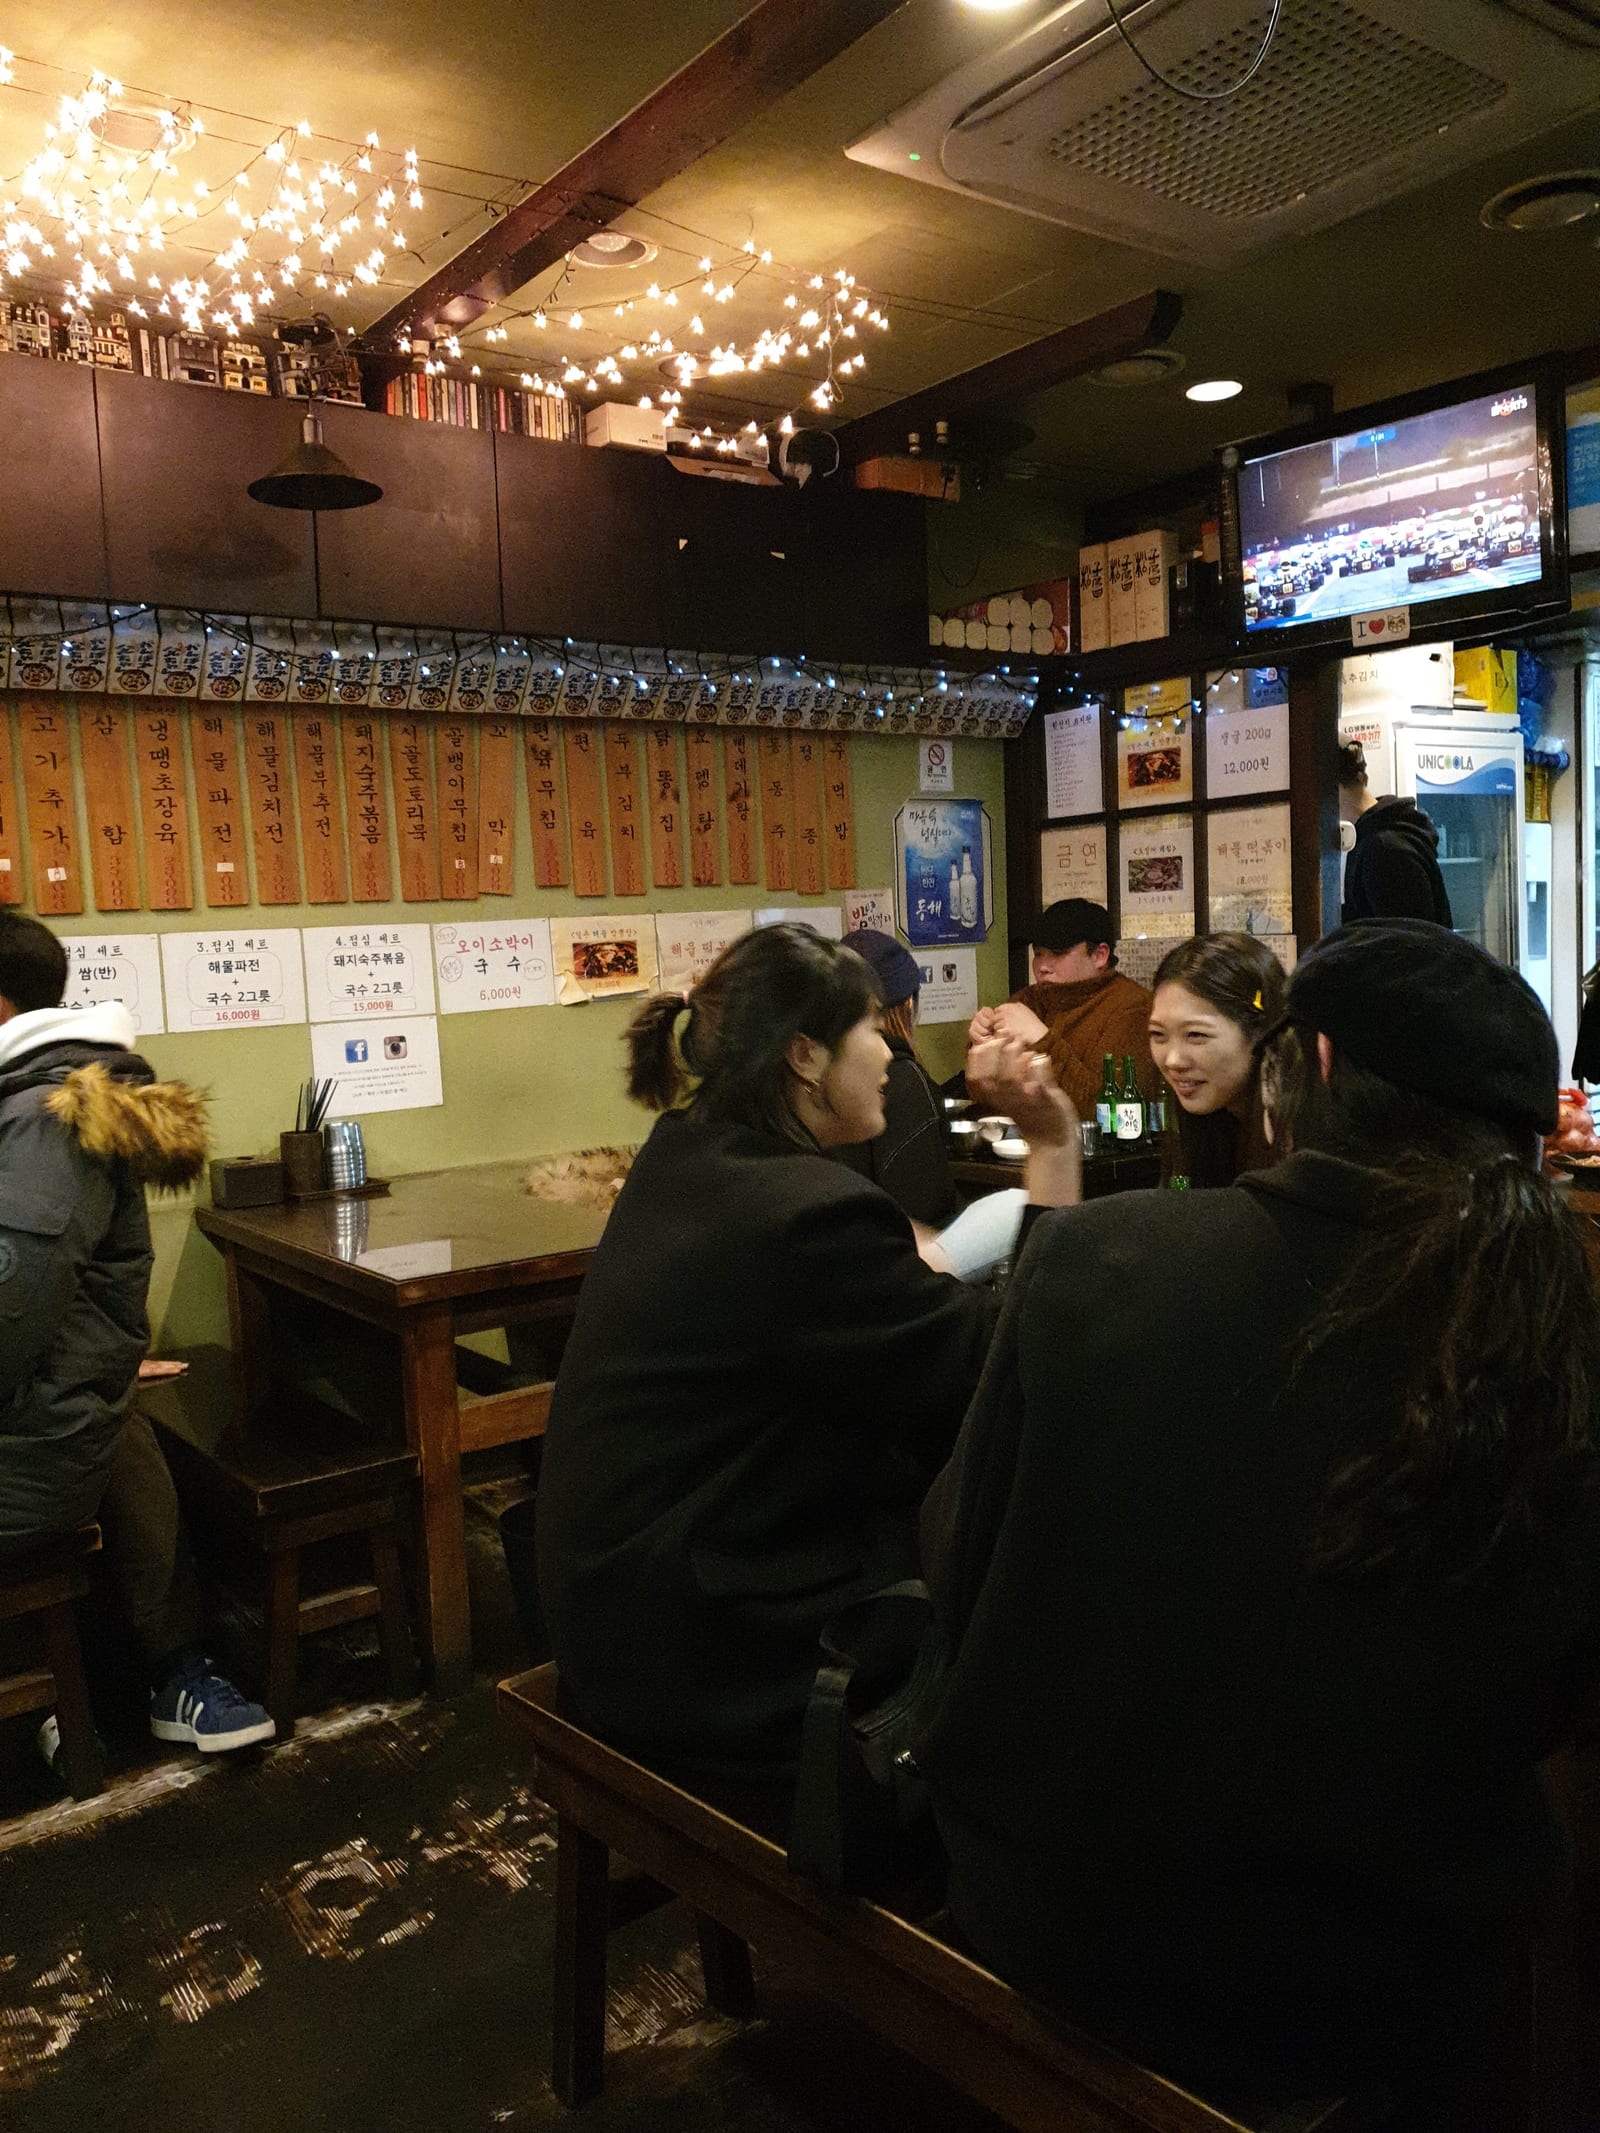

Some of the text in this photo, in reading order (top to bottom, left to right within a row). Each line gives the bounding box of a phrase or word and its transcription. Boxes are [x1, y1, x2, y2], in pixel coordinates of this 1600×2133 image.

[1357, 621, 1367, 638] I
[31, 717, 69, 844] 고기추가
[92, 714, 127, 845] 삼합
[203, 718, 233, 843] 해물파전
[256, 721, 284, 844] 해물김치전
[306, 722, 331, 838] 해물부추전
[401, 724, 428, 842] 시골도토리묵
[489, 725, 507, 836] 꼬막
[534, 722, 556, 830] 편육무침
[654, 729, 674, 833] 닭똥집
[1245, 728, 1271, 741] 200g
[355, 724, 381, 844] 돼지숙주볶음
[445, 727, 468, 842] 골뱅이무침
[574, 733, 597, 839] 편육
[614, 733, 635, 840] 두부김치
[830, 743, 849, 840] 주먹밥
[97, 945, 123, 957] 세트
[196, 939, 269, 953] 3.점심 세트
[335, 932, 401, 947] 4.점심 세트
[456, 933, 534, 954] 오이소박이
[916, 898, 942, 922] 동해
[207, 989, 271, 1005] 국수 2그릇
[208, 959, 260, 973] 해물파전
[333, 952, 405, 967] 돼지숙주볶음
[345, 982, 404, 997] 국수 2그릇
[353, 1001, 394, 1012] 15,000원
[216, 1010, 261, 1022] 16,000원
